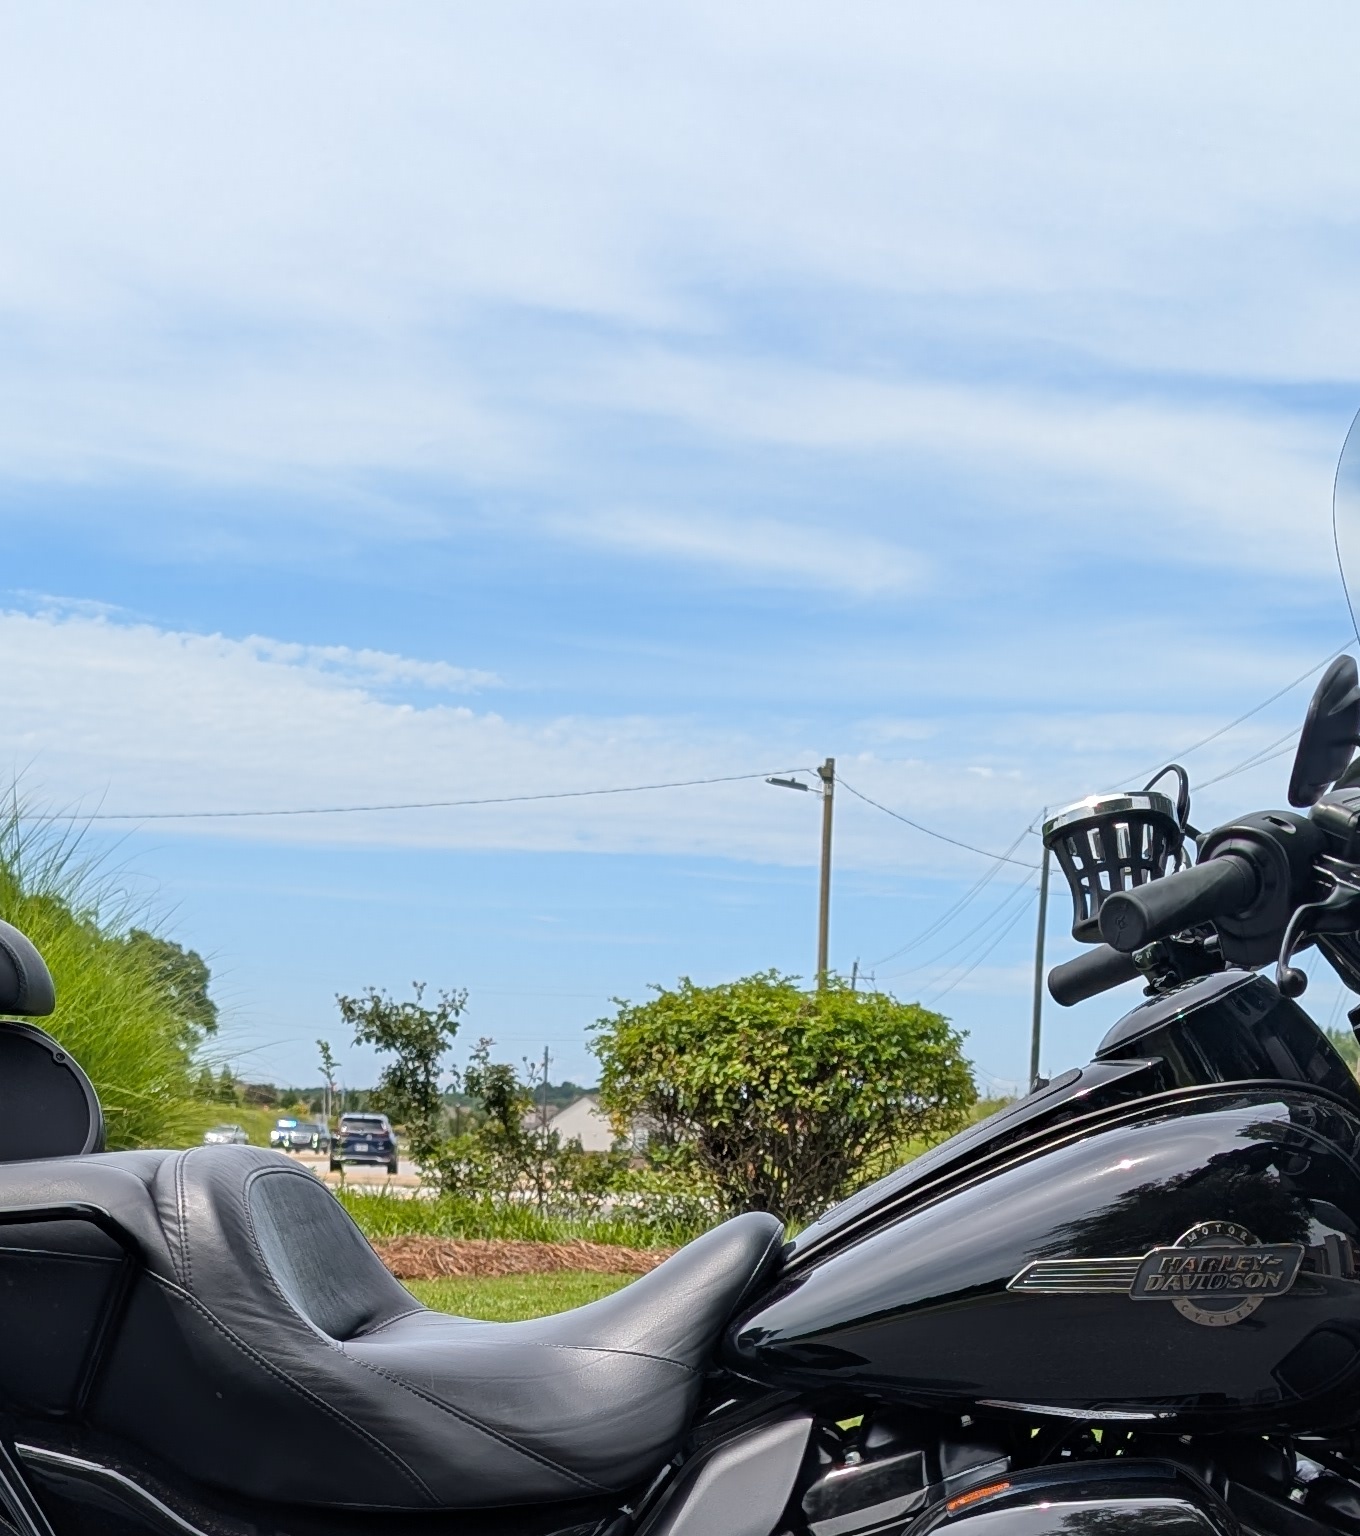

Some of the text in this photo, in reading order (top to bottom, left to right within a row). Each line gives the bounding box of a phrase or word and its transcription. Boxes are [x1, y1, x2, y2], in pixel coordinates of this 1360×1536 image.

[1186, 1223, 1248, 1242] MOTOR
[1159, 1254, 1283, 1273] HARLEY-
[1144, 1273, 1282, 1291] DAVIDSON
[1181, 1303, 1254, 1324] CYCLES
